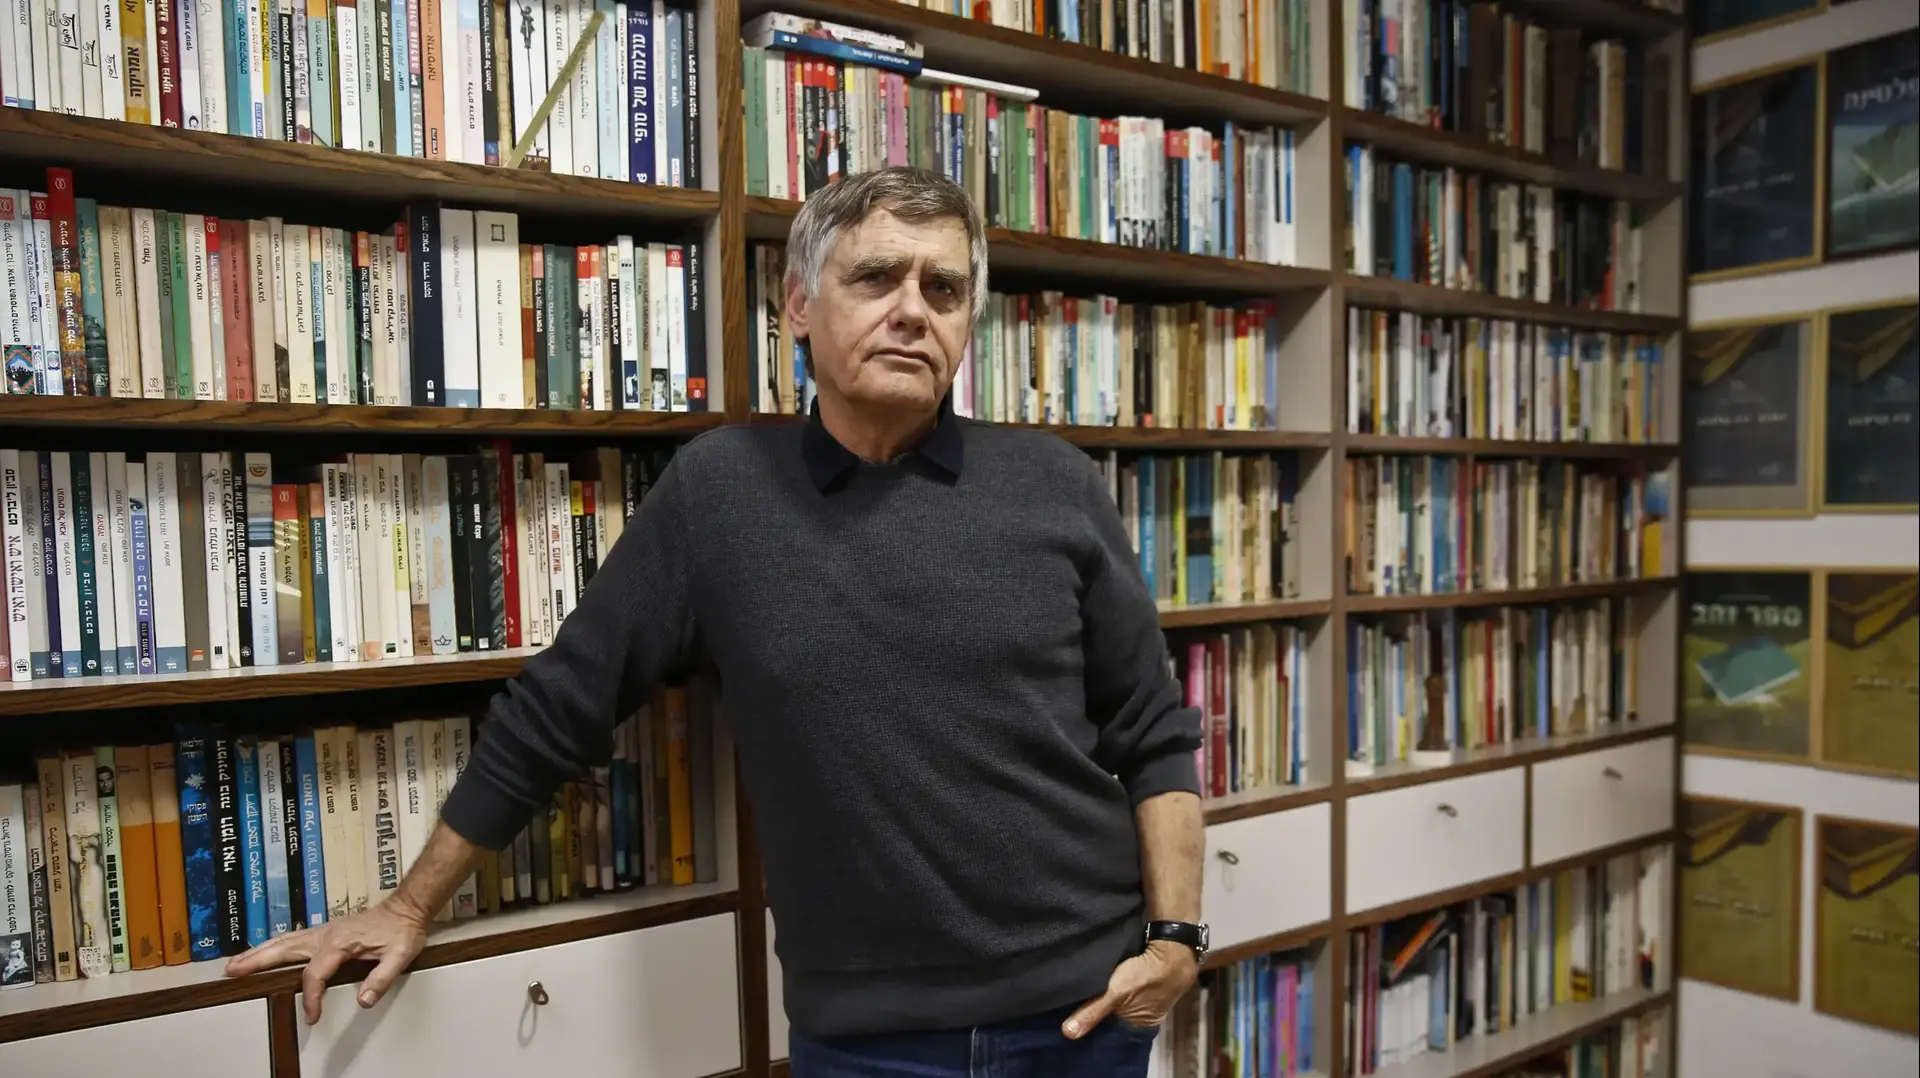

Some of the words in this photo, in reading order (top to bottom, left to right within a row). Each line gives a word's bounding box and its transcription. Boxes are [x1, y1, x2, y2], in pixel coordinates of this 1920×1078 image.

[427, 35, 436, 81] אודיסיאה
[632, 34, 646, 80] עולמה
[127, 47, 144, 97] אמריקה
[633, 86, 646, 107] של
[634, 113, 647, 143] סופי
[3, 223, 12, 241] מייקל
[60, 221, 68, 245] צ'ינגיס
[62, 248, 72, 283] אייטמטוב
[142, 248, 151, 264] סולל
[8, 268, 16, 287] איגוד
[194, 272, 201, 281] אל
[422, 261, 431, 279] הידיד
[65, 287, 73, 307] והיום
[423, 281, 432, 298] הקטן
[8, 289, 18, 317] השוטרים
[296, 307, 303, 316] של
[66, 309, 74, 327] איננו
[66, 329, 75, 344] כלה
[5, 469, 16, 489] סביון
[234, 476, 242, 488] אורי
[6, 492, 17, 525] ליברכט
[57, 488, 65, 509] הנשים
[222, 493, 233, 524] כליפה
[236, 492, 244, 513] אדלמן
[56, 509, 65, 520] של
[115, 507, 122, 516] של
[134, 520, 145, 538] סוזן
[209, 527, 217, 549] בעלת
[236, 522, 245, 549] קונצ'רטו
[552, 524, 560, 545] אושר
[9, 536, 21, 557] איש
[135, 542, 145, 560] אדם
[226, 529, 234, 563] הצבר
[211, 552, 219, 571] הבית
[237, 553, 246, 574] למרגל
[259, 552, 267, 585] משפחתי
[11, 560, 24, 593] ואישה
[84, 573, 92, 595] סביון
[137, 575, 147, 616] כביסה
[239, 577, 248, 607] ולתזמורת
[257, 588, 268, 605] רומן
[13, 597, 25, 622] ואיש
[85, 600, 93, 634] ליברכט
[1692, 604, 1736, 626] זהב
[1747, 605, 1802, 628] ספר
[217, 740, 229, 780] דומיניק
[375, 735, 386, 770] גינטר
[264, 770, 275, 793] לורנס
[303, 774, 313, 806] המאה
[326, 786, 333, 795] דג
[73, 801, 85, 813] בל
[220, 785, 230, 809] בונה
[246, 793, 258, 816] דיוקן
[268, 798, 277, 824] הקשת
[286, 799, 295, 822] חתול
[305, 810, 315, 831] שלי
[1, 819, 10, 840] גבריאל
[48, 827, 58, 854] ביליארד
[221, 817, 236, 842] רומן
[248, 820, 259, 848] האמן
[270, 827, 281, 844] בענן
[289, 827, 298, 855] ועכבר
[376, 812, 395, 848] תוף
[223, 846, 236, 872] גארי
[249, 851, 259, 877] כאיש
[307, 841, 318, 865] גינטר
[6, 859, 14, 878] מארקס
[51, 856, 61, 875] בתשע
[378, 849, 397, 890] הפח
[251, 880, 262, 904] צעיר
[309, 869, 320, 894] גראס
[6, 885, 15, 902] לחיות
[32, 896, 42, 907] של
[228, 889, 237, 914] ספרית
[8, 904, 16, 915] כדי
[9, 916, 17, 932] לספר
[230, 917, 240, 941] מעריב
